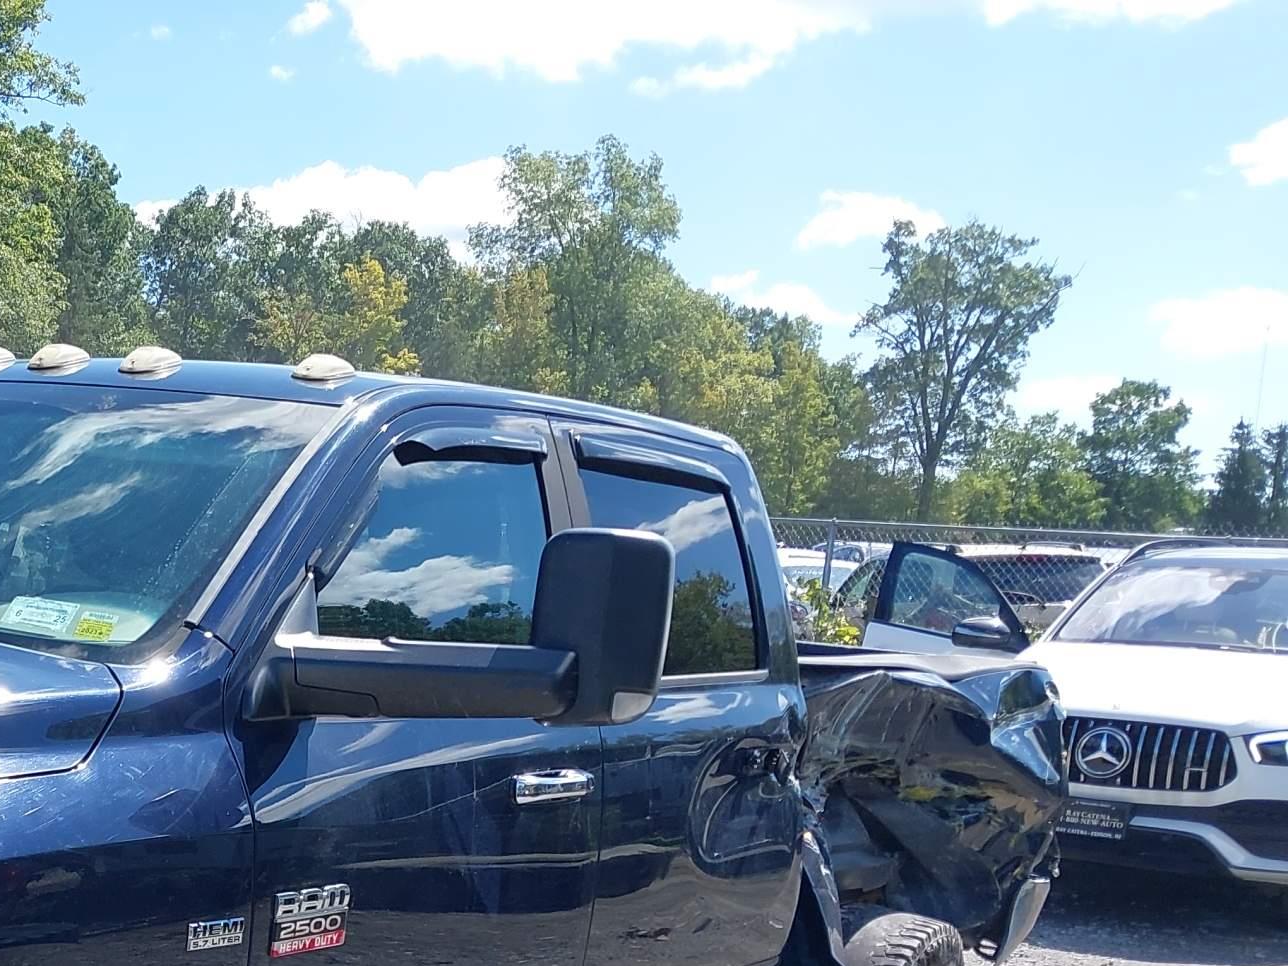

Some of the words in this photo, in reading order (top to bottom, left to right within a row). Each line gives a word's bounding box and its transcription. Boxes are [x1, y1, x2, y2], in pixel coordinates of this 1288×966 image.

[15, 609, 23, 617] 6
[53, 615, 67, 624] 25
[189, 917, 245, 939] HEMI
[280, 915, 341, 939] 2500
[192, 939, 209, 949] 5.7
[211, 935, 241, 946] LITER
[279, 938, 311, 954] HEAVY
[314, 931, 339, 948] DUTY
